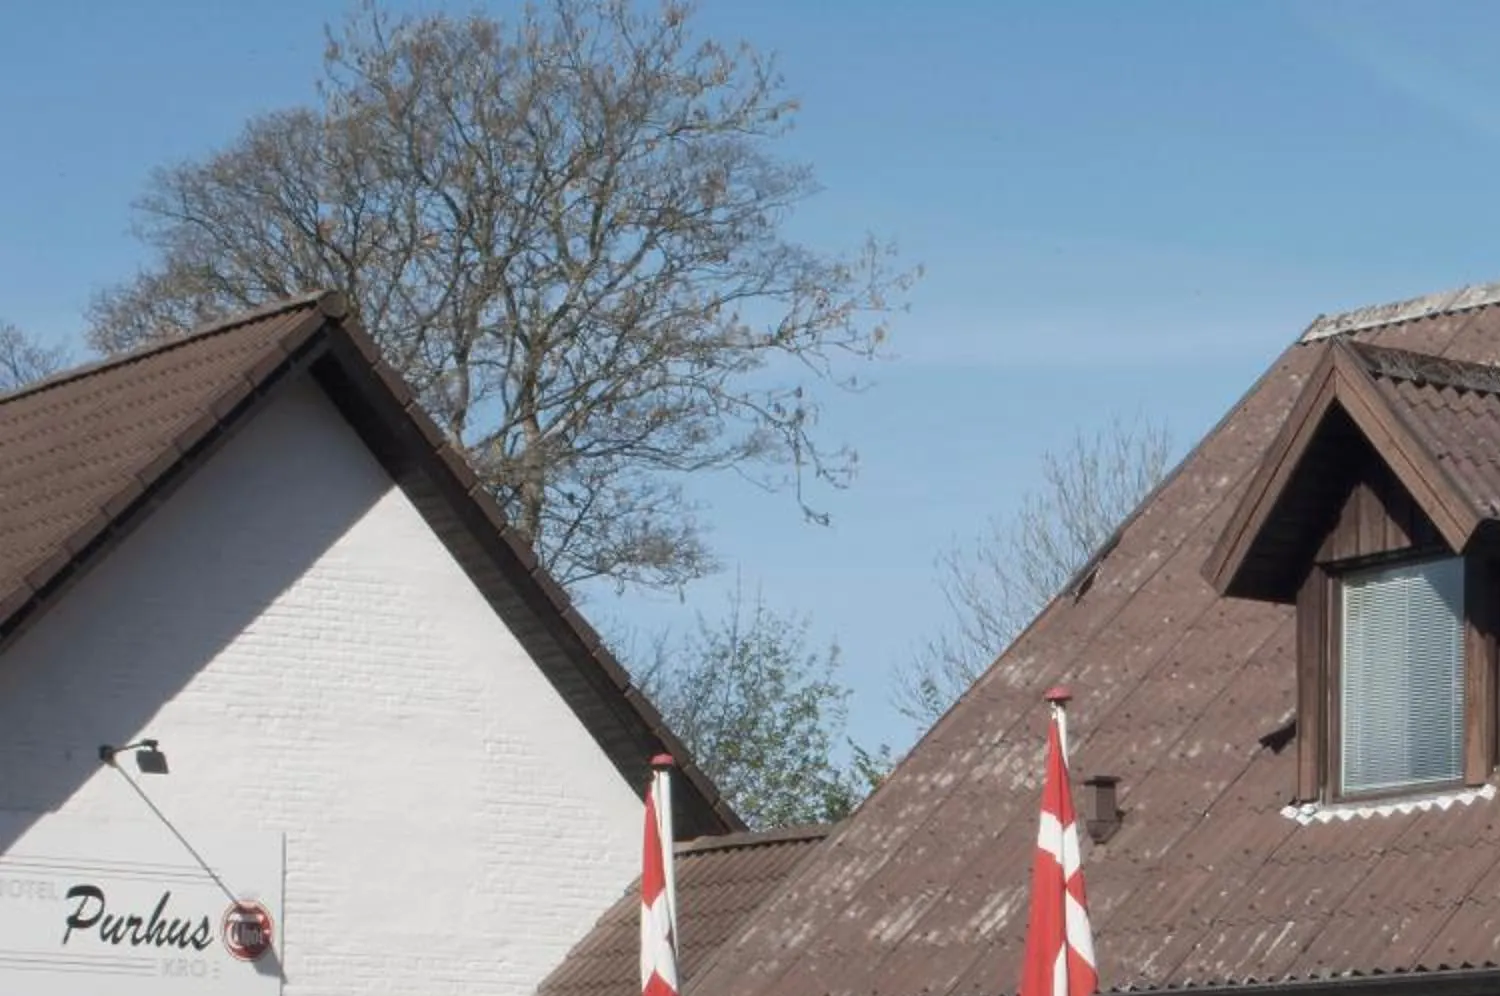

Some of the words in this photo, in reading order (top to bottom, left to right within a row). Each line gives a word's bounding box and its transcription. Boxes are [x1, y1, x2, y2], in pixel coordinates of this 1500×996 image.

[0, 879, 58, 900] OTEL
[62, 885, 214, 951] Purhus
[161, 956, 207, 978] KRO
